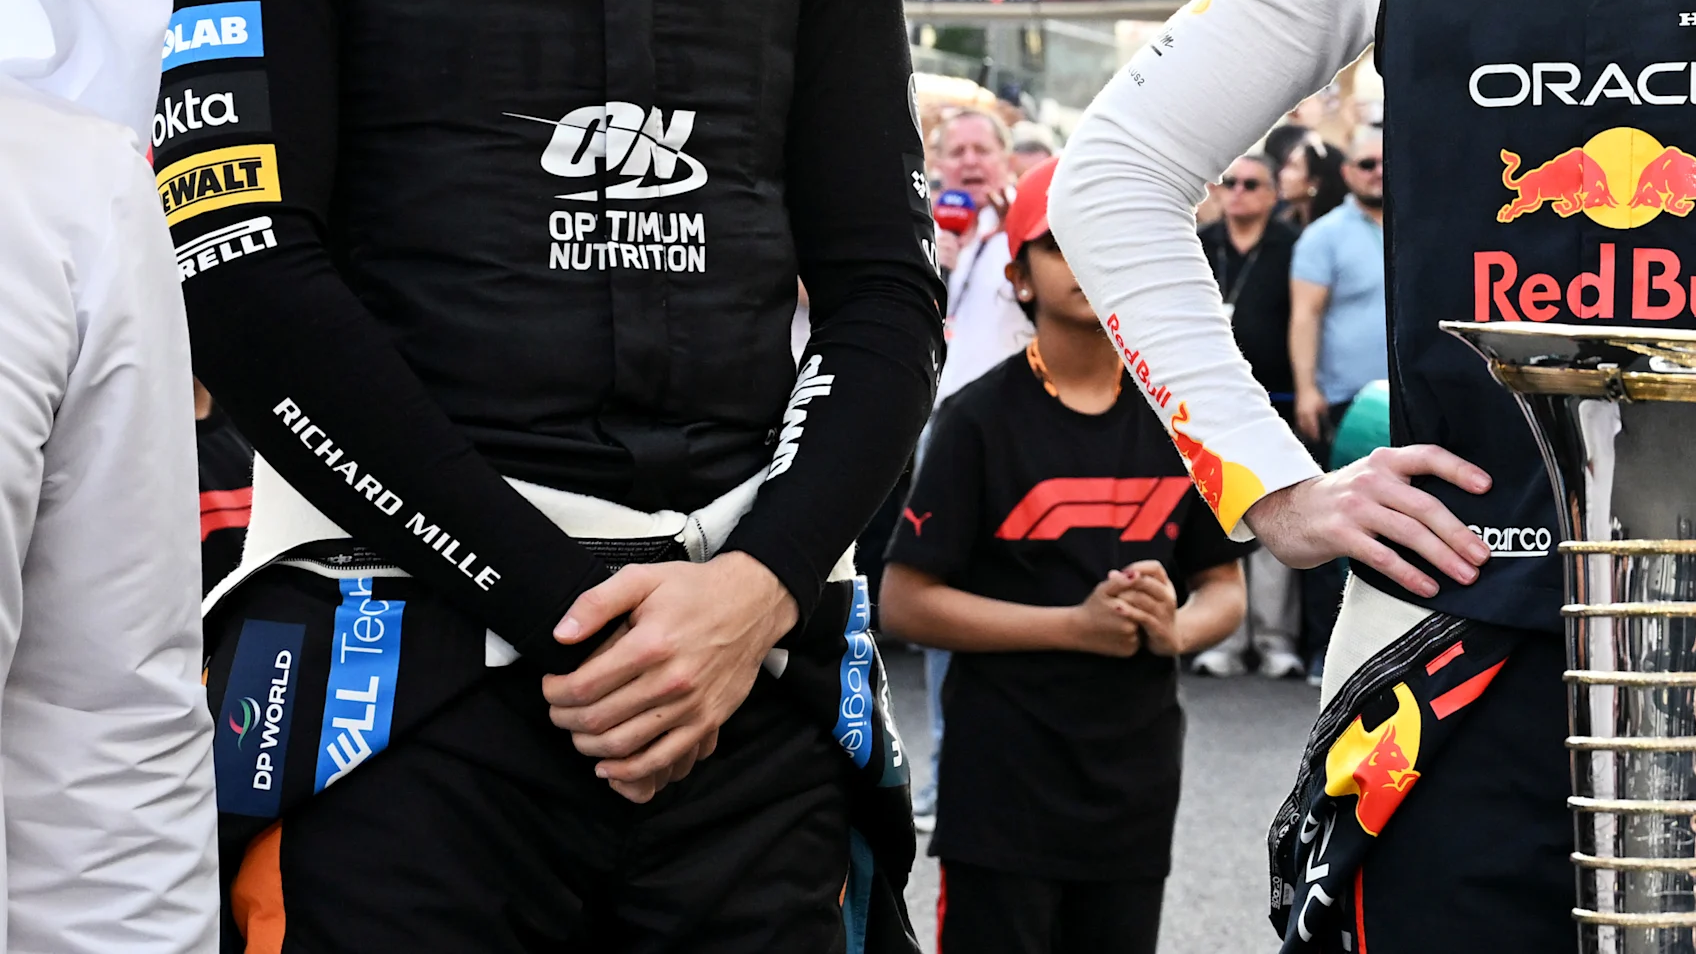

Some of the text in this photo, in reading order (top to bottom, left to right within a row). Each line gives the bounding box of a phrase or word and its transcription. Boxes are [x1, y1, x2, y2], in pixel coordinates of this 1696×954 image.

[152, 88, 239, 148] okta
[159, 160, 263, 212] EWALT
[549, 210, 706, 244] OPTIMUM
[549, 242, 706, 273] NUTRITION
[1474, 243, 1615, 322] Red
[1107, 313, 1172, 409] Red Bull
[272, 396, 501, 592] RICHARD MILLE
[253, 649, 292, 791] DP WORLD
